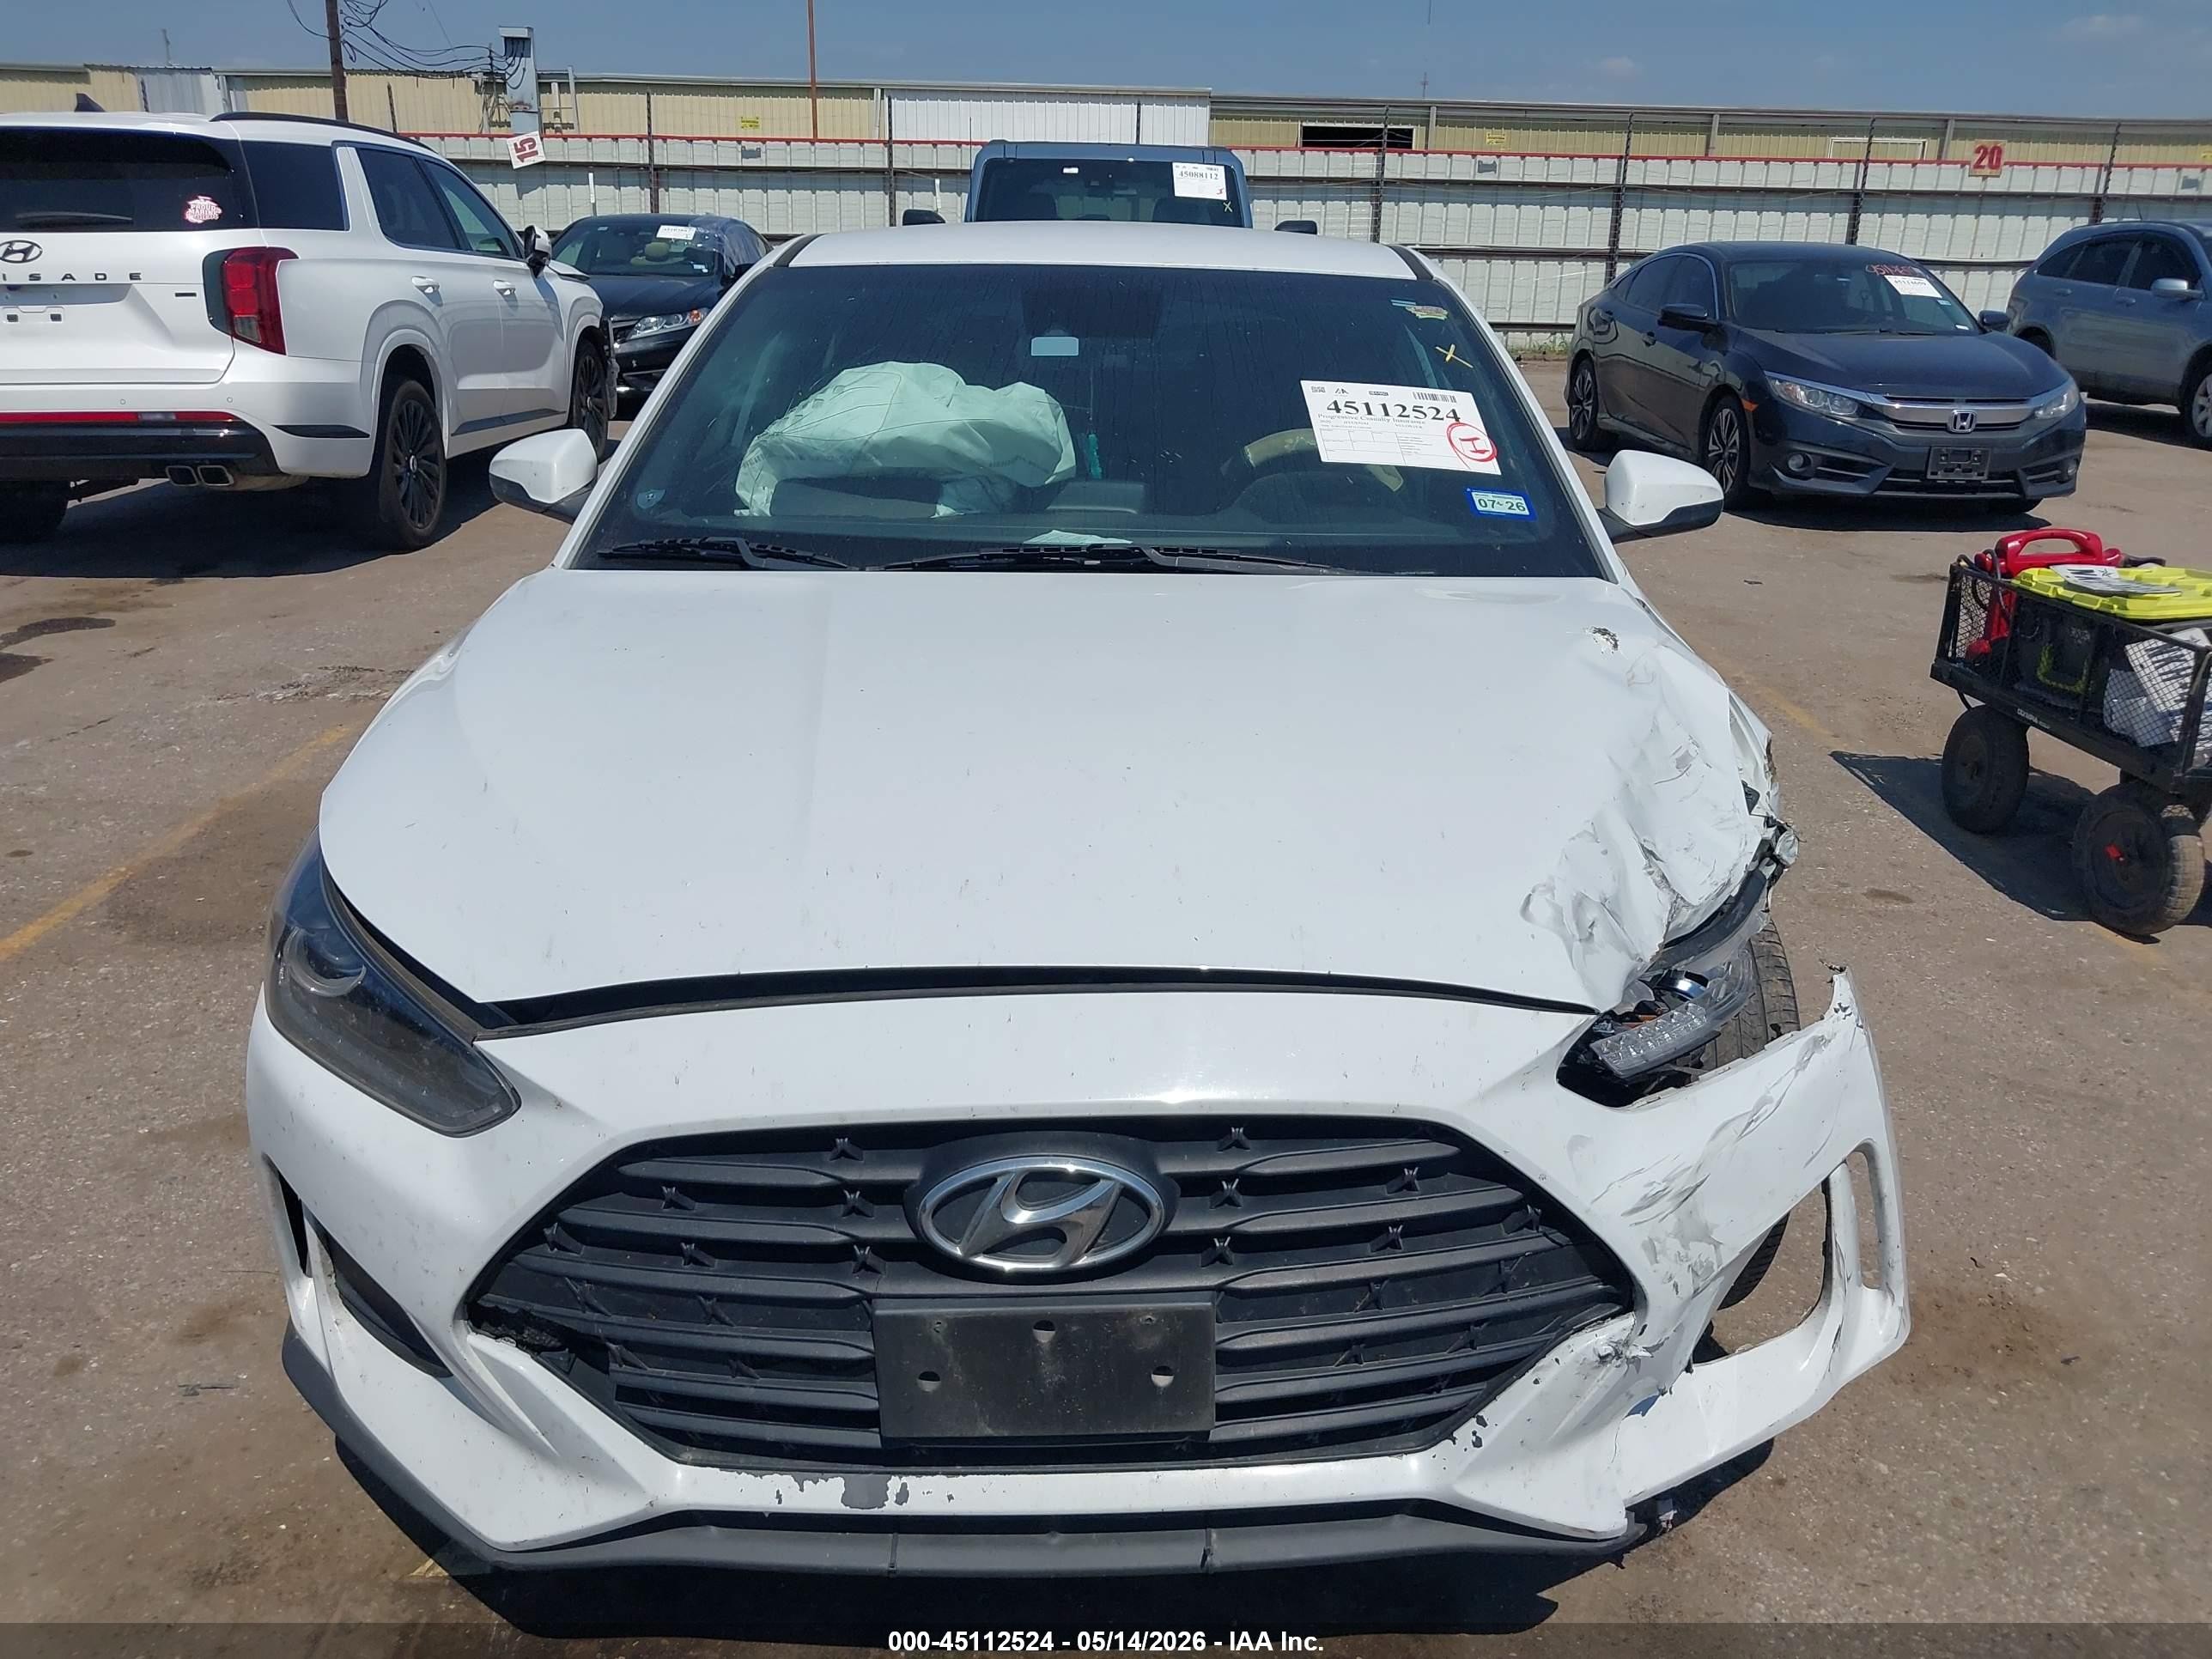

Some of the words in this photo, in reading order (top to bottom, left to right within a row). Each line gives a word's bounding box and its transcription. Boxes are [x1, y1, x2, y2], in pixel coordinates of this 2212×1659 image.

[513, 137, 539, 163] 15
[1972, 144, 2002, 170] 20
[1327, 399, 1461, 422] 45112524
[1478, 498, 1496, 509] 07
[1505, 501, 1526, 512] 26
